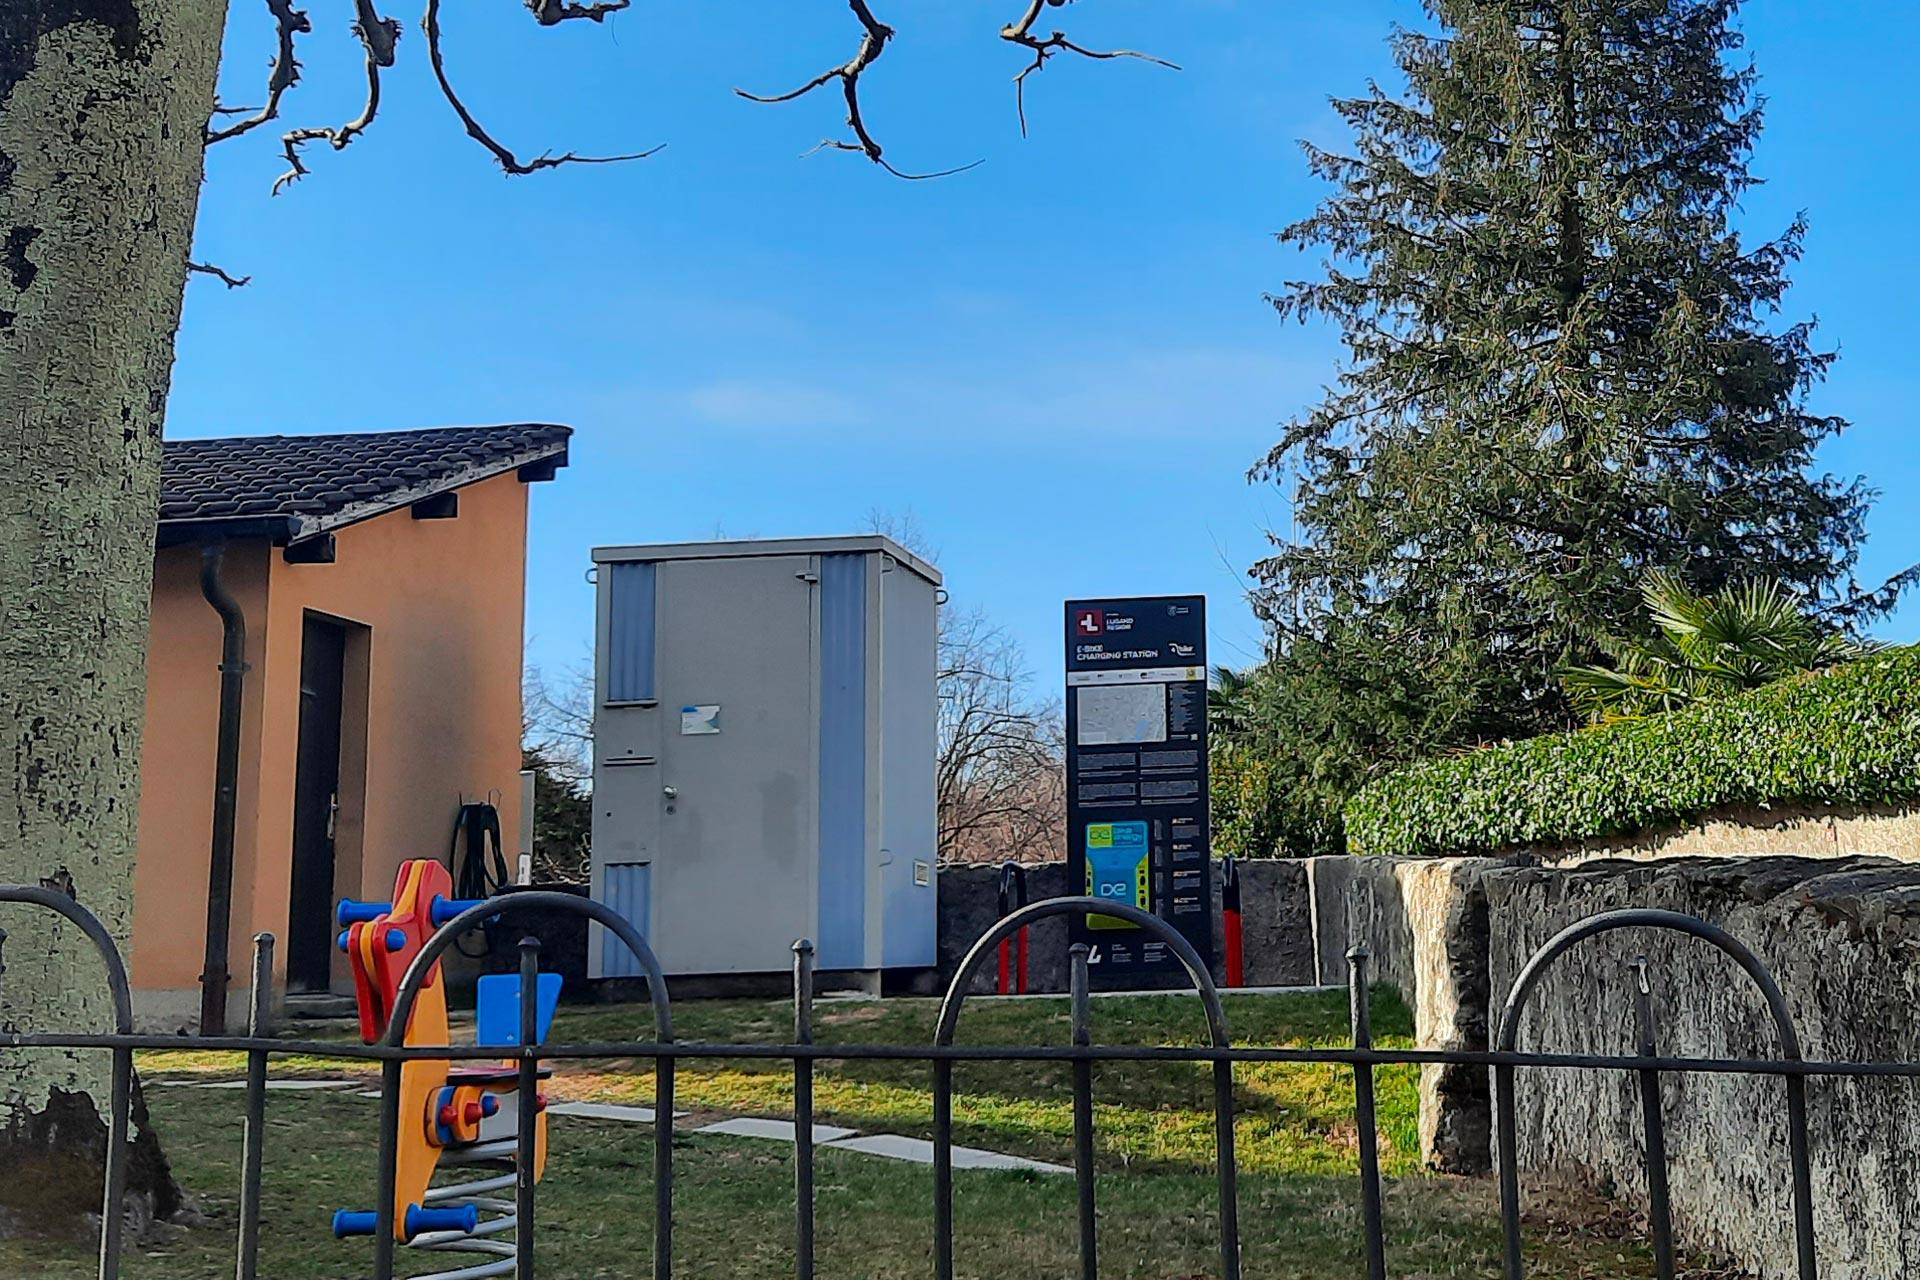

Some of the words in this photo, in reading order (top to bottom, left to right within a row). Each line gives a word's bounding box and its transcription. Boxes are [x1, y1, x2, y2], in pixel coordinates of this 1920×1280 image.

[1076, 644, 1103, 653] E-BIKE
[1076, 652, 1121, 661] CHARGING
[1122, 650, 1159, 659] STATION
